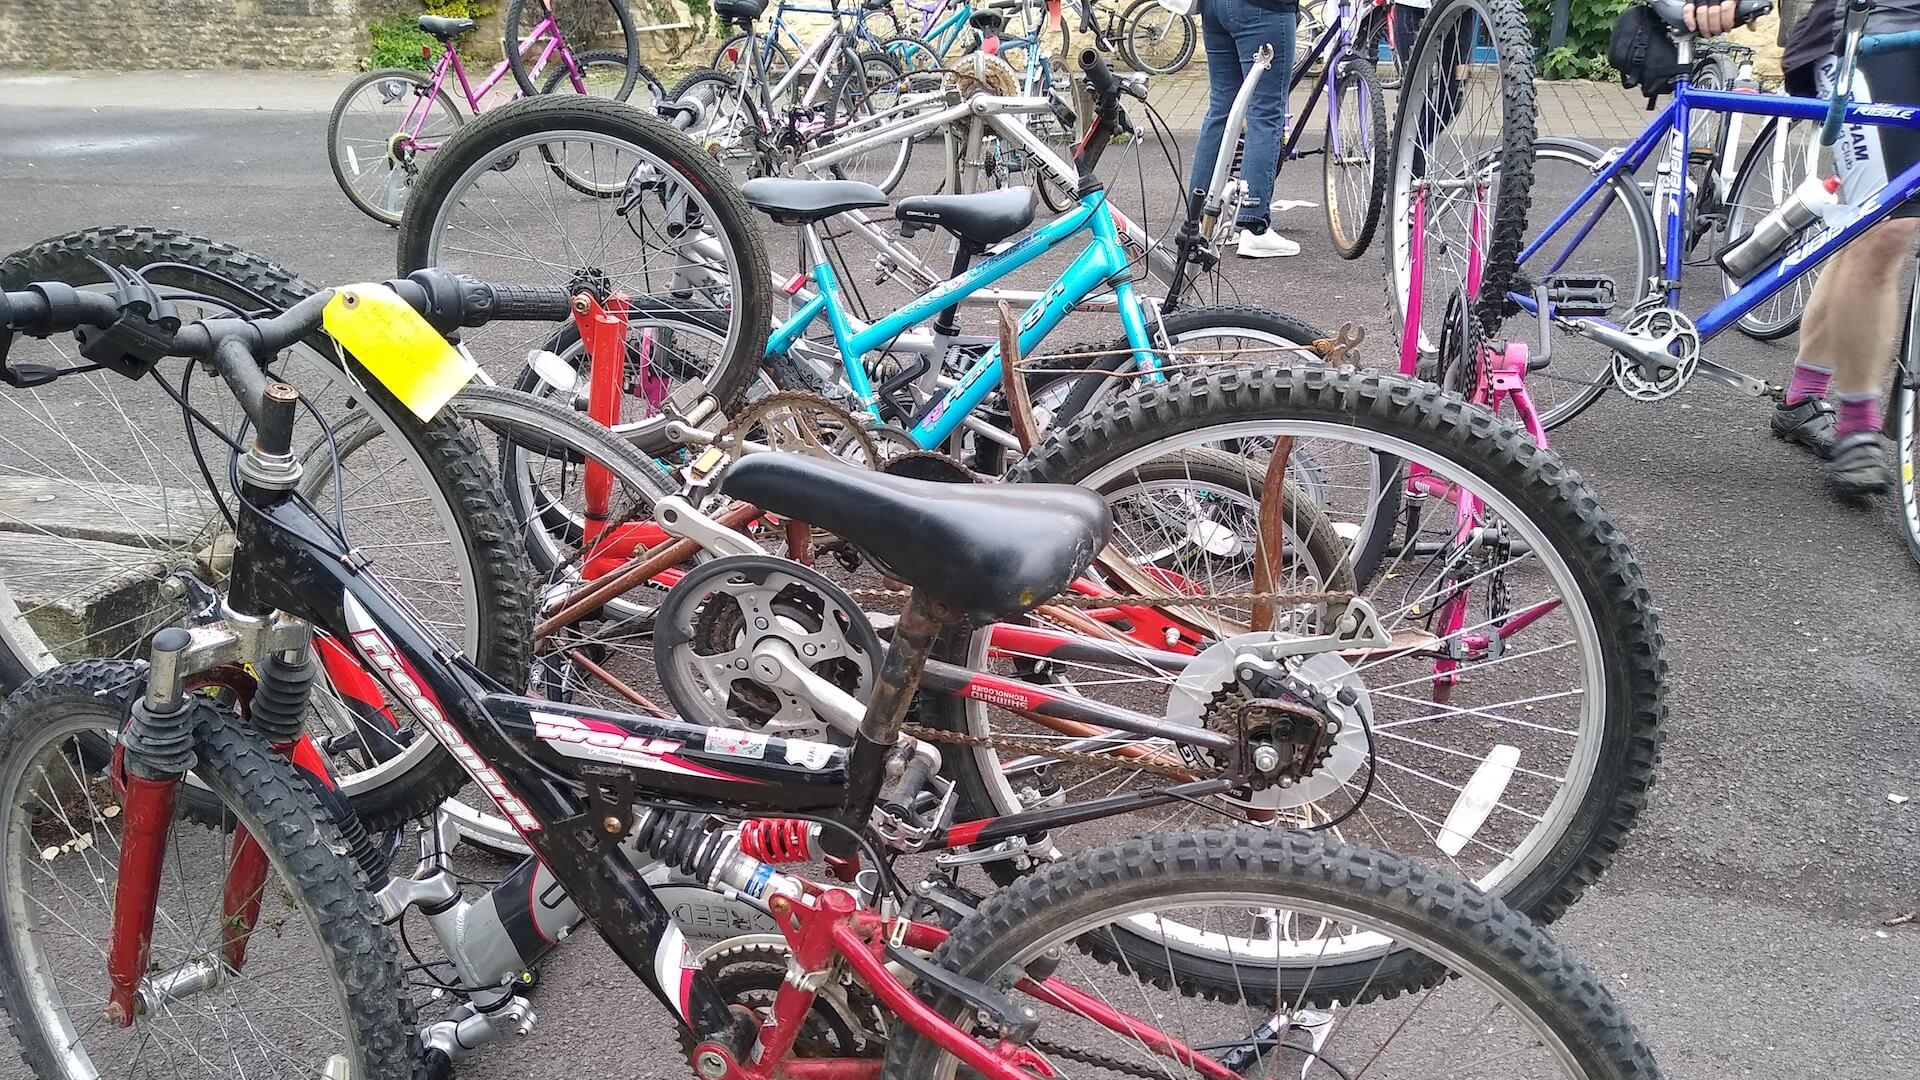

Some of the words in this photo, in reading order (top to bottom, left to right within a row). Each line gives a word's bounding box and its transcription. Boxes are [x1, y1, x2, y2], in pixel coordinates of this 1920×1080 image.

[1853, 105, 1915, 120] RIBBLE
[1668, 128, 1684, 217] RIBBLE
[970, 691, 1028, 710] SHIMANO
[971, 684, 1029, 703] TECHNOLOGIES
[353, 631, 541, 830] Freespirit
[535, 722, 684, 755] WOLF
